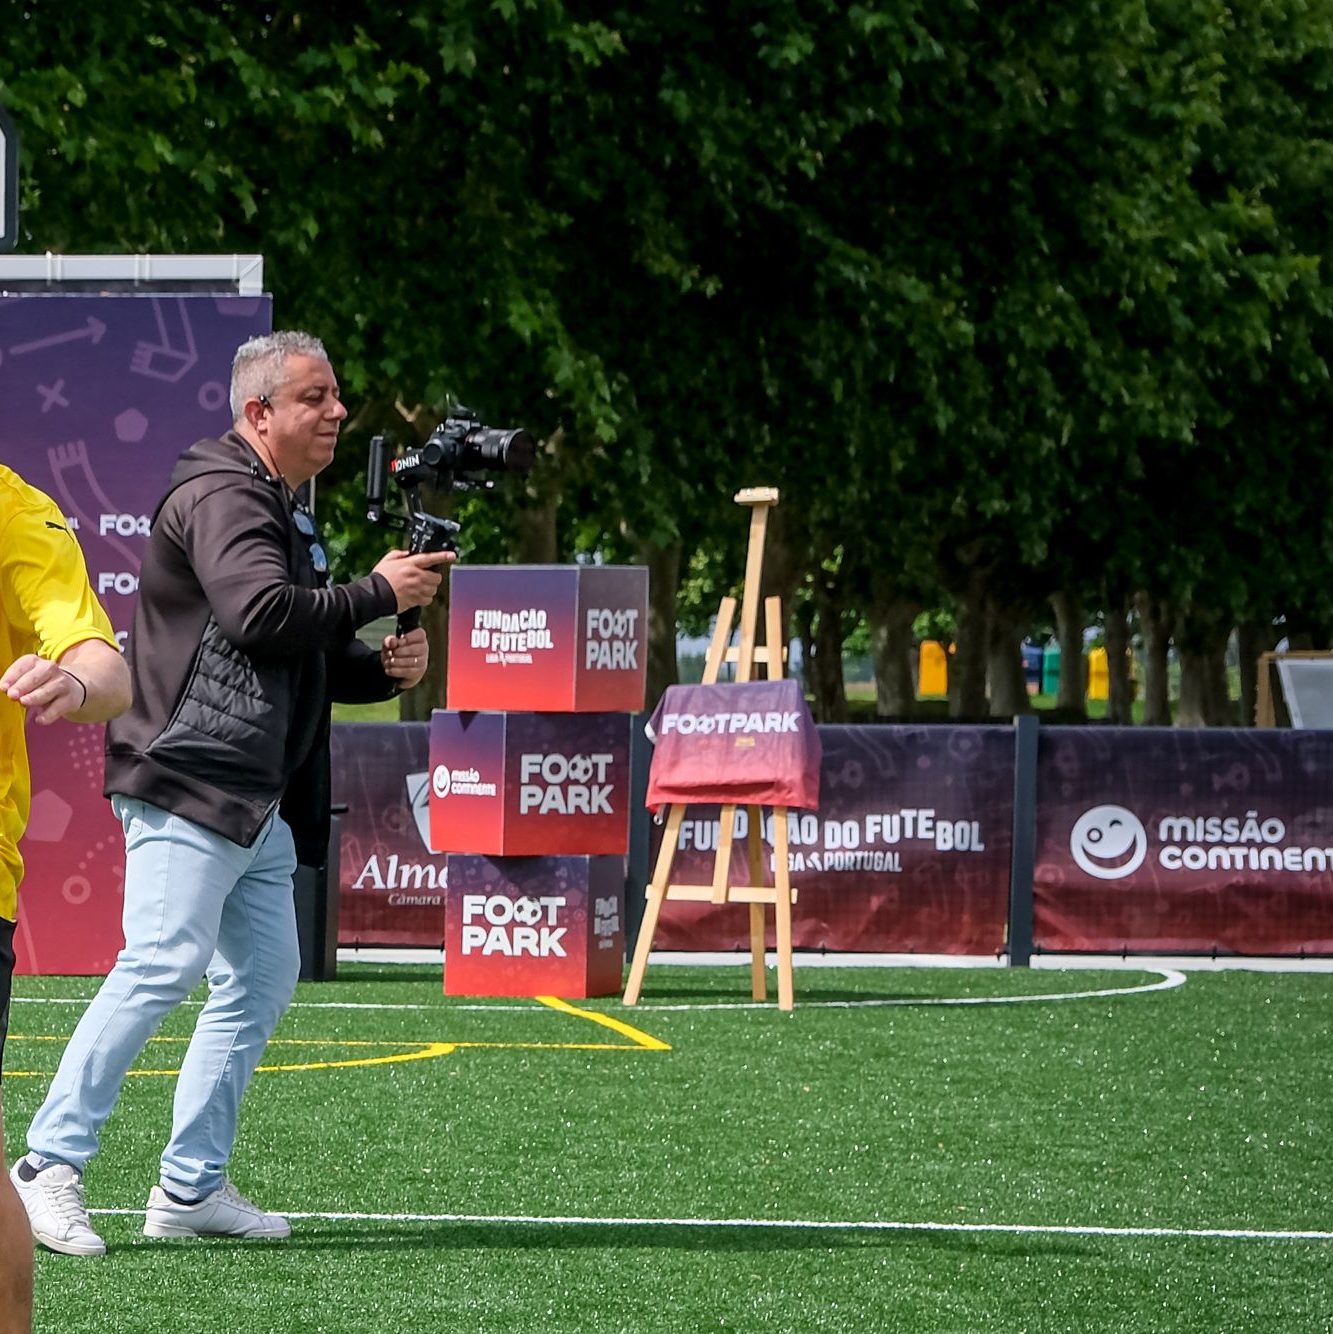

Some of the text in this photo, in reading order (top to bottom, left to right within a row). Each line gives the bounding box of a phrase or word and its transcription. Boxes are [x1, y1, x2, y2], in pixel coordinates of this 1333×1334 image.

[474, 608, 547, 633] FUNDAÇÃO
[471, 629, 554, 652] DO FUTEBOL
[585, 639, 638, 670] PARK
[520, 784, 614, 814] PARK
[824, 820, 860, 849] DO
[866, 808, 985, 851] FUTEBOL
[1158, 810, 1286, 844] MISSÃO
[823, 851, 902, 872] PORTUGAL
[387, 892, 441, 906] Câmara
[462, 927, 567, 957] PARK
